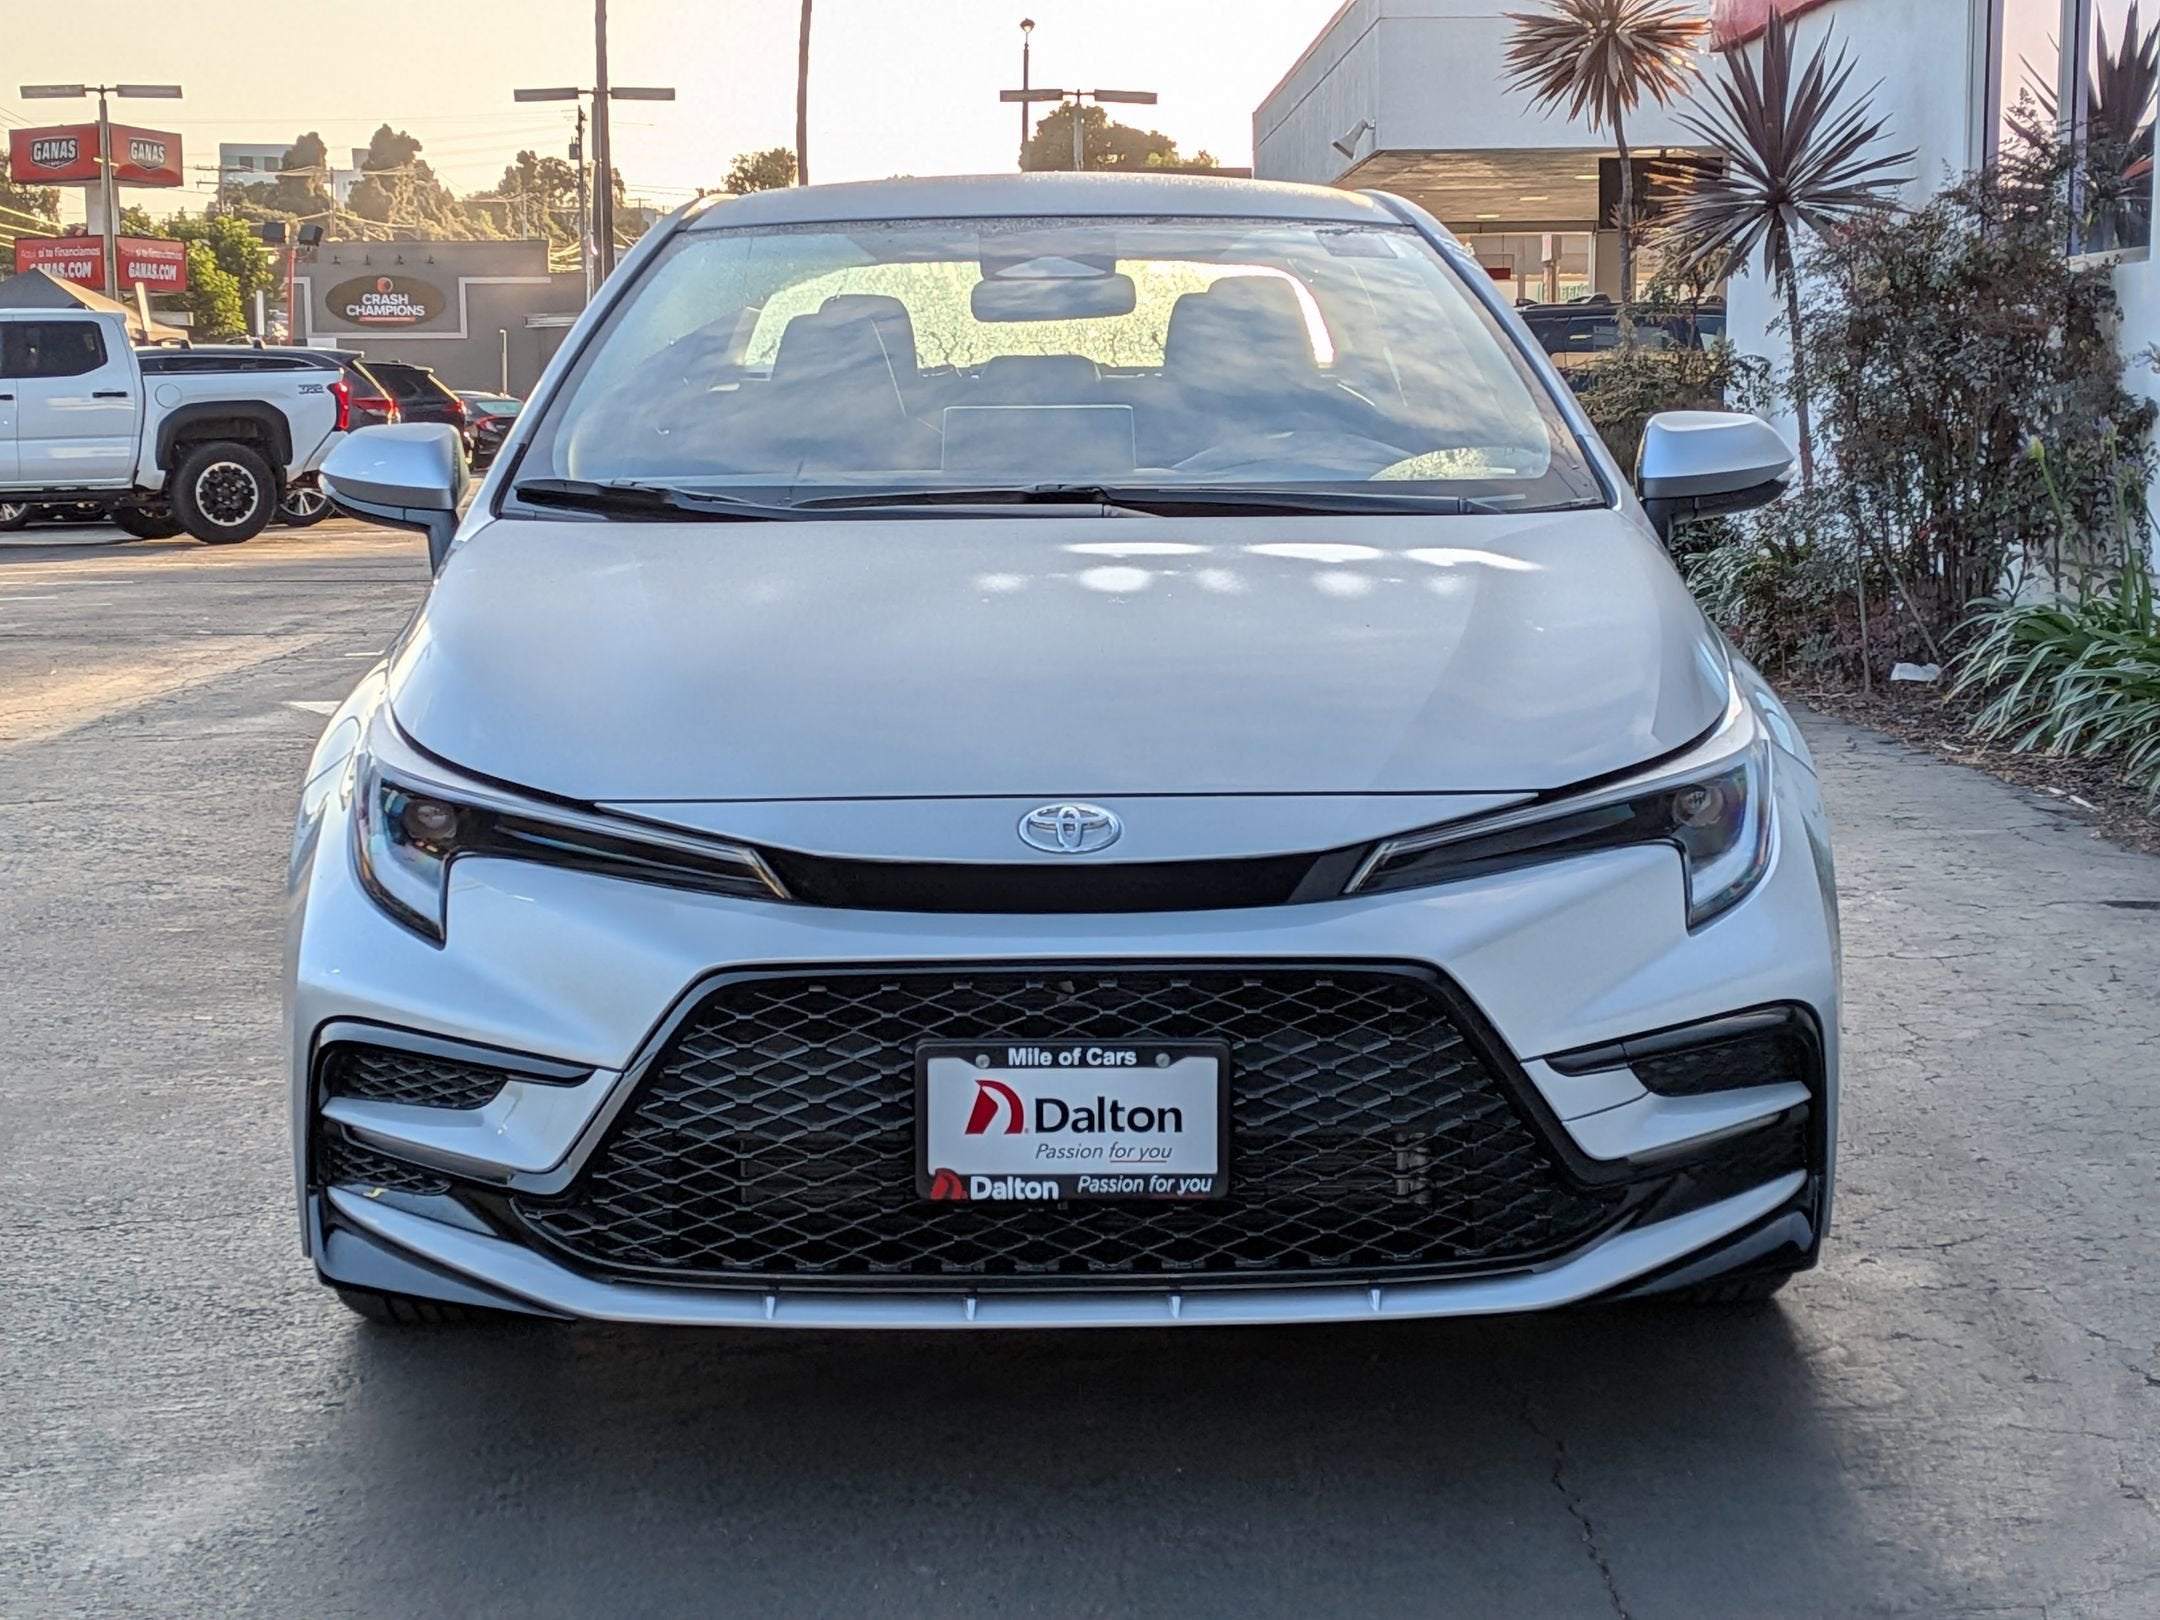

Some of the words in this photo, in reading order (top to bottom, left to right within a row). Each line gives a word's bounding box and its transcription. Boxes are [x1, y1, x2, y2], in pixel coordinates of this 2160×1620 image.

[33, 140, 76, 161] GANAS
[130, 142, 165, 163] GANAS
[128, 262, 177, 281] GANAS.COM
[362, 293, 409, 305] CRASH
[346, 304, 425, 316] CHAMPIONS
[1008, 1048, 1051, 1066] Mile
[1058, 1048, 1081, 1066] of
[1086, 1048, 1137, 1066] Cars
[1035, 1096, 1183, 1134] Dalton
[1035, 1143, 1103, 1160] Passion
[1109, 1142, 1134, 1160] for
[1136, 1147, 1173, 1162] you
[970, 1176, 1059, 1200] Dalton
[1077, 1176, 1144, 1193] Passion
[1150, 1176, 1176, 1194] for
[1178, 1178, 1212, 1196] you
